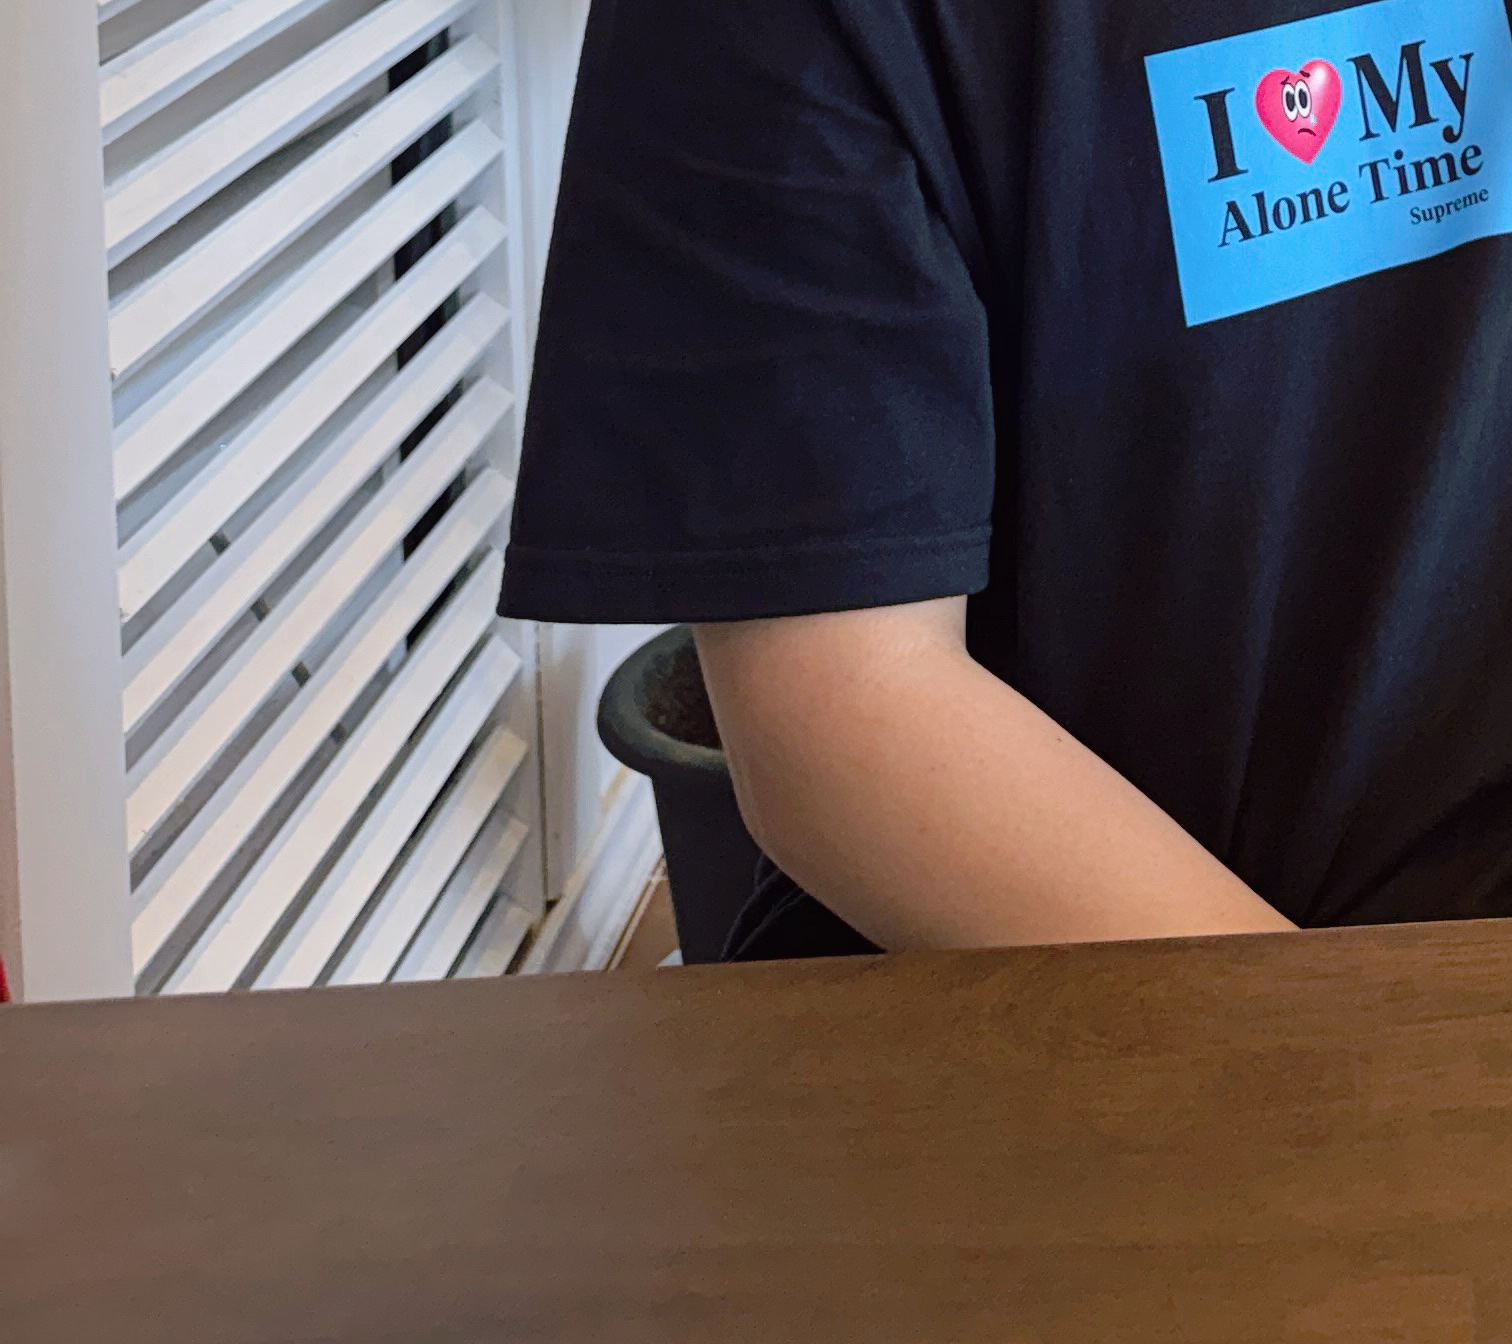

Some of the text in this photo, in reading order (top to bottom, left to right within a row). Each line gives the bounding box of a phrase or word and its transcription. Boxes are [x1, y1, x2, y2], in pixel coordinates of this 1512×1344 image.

[1195, 40, 1474, 183] I My
[1218, 143, 1485, 248] Alone Time
[1409, 187, 1489, 226] Supreme
